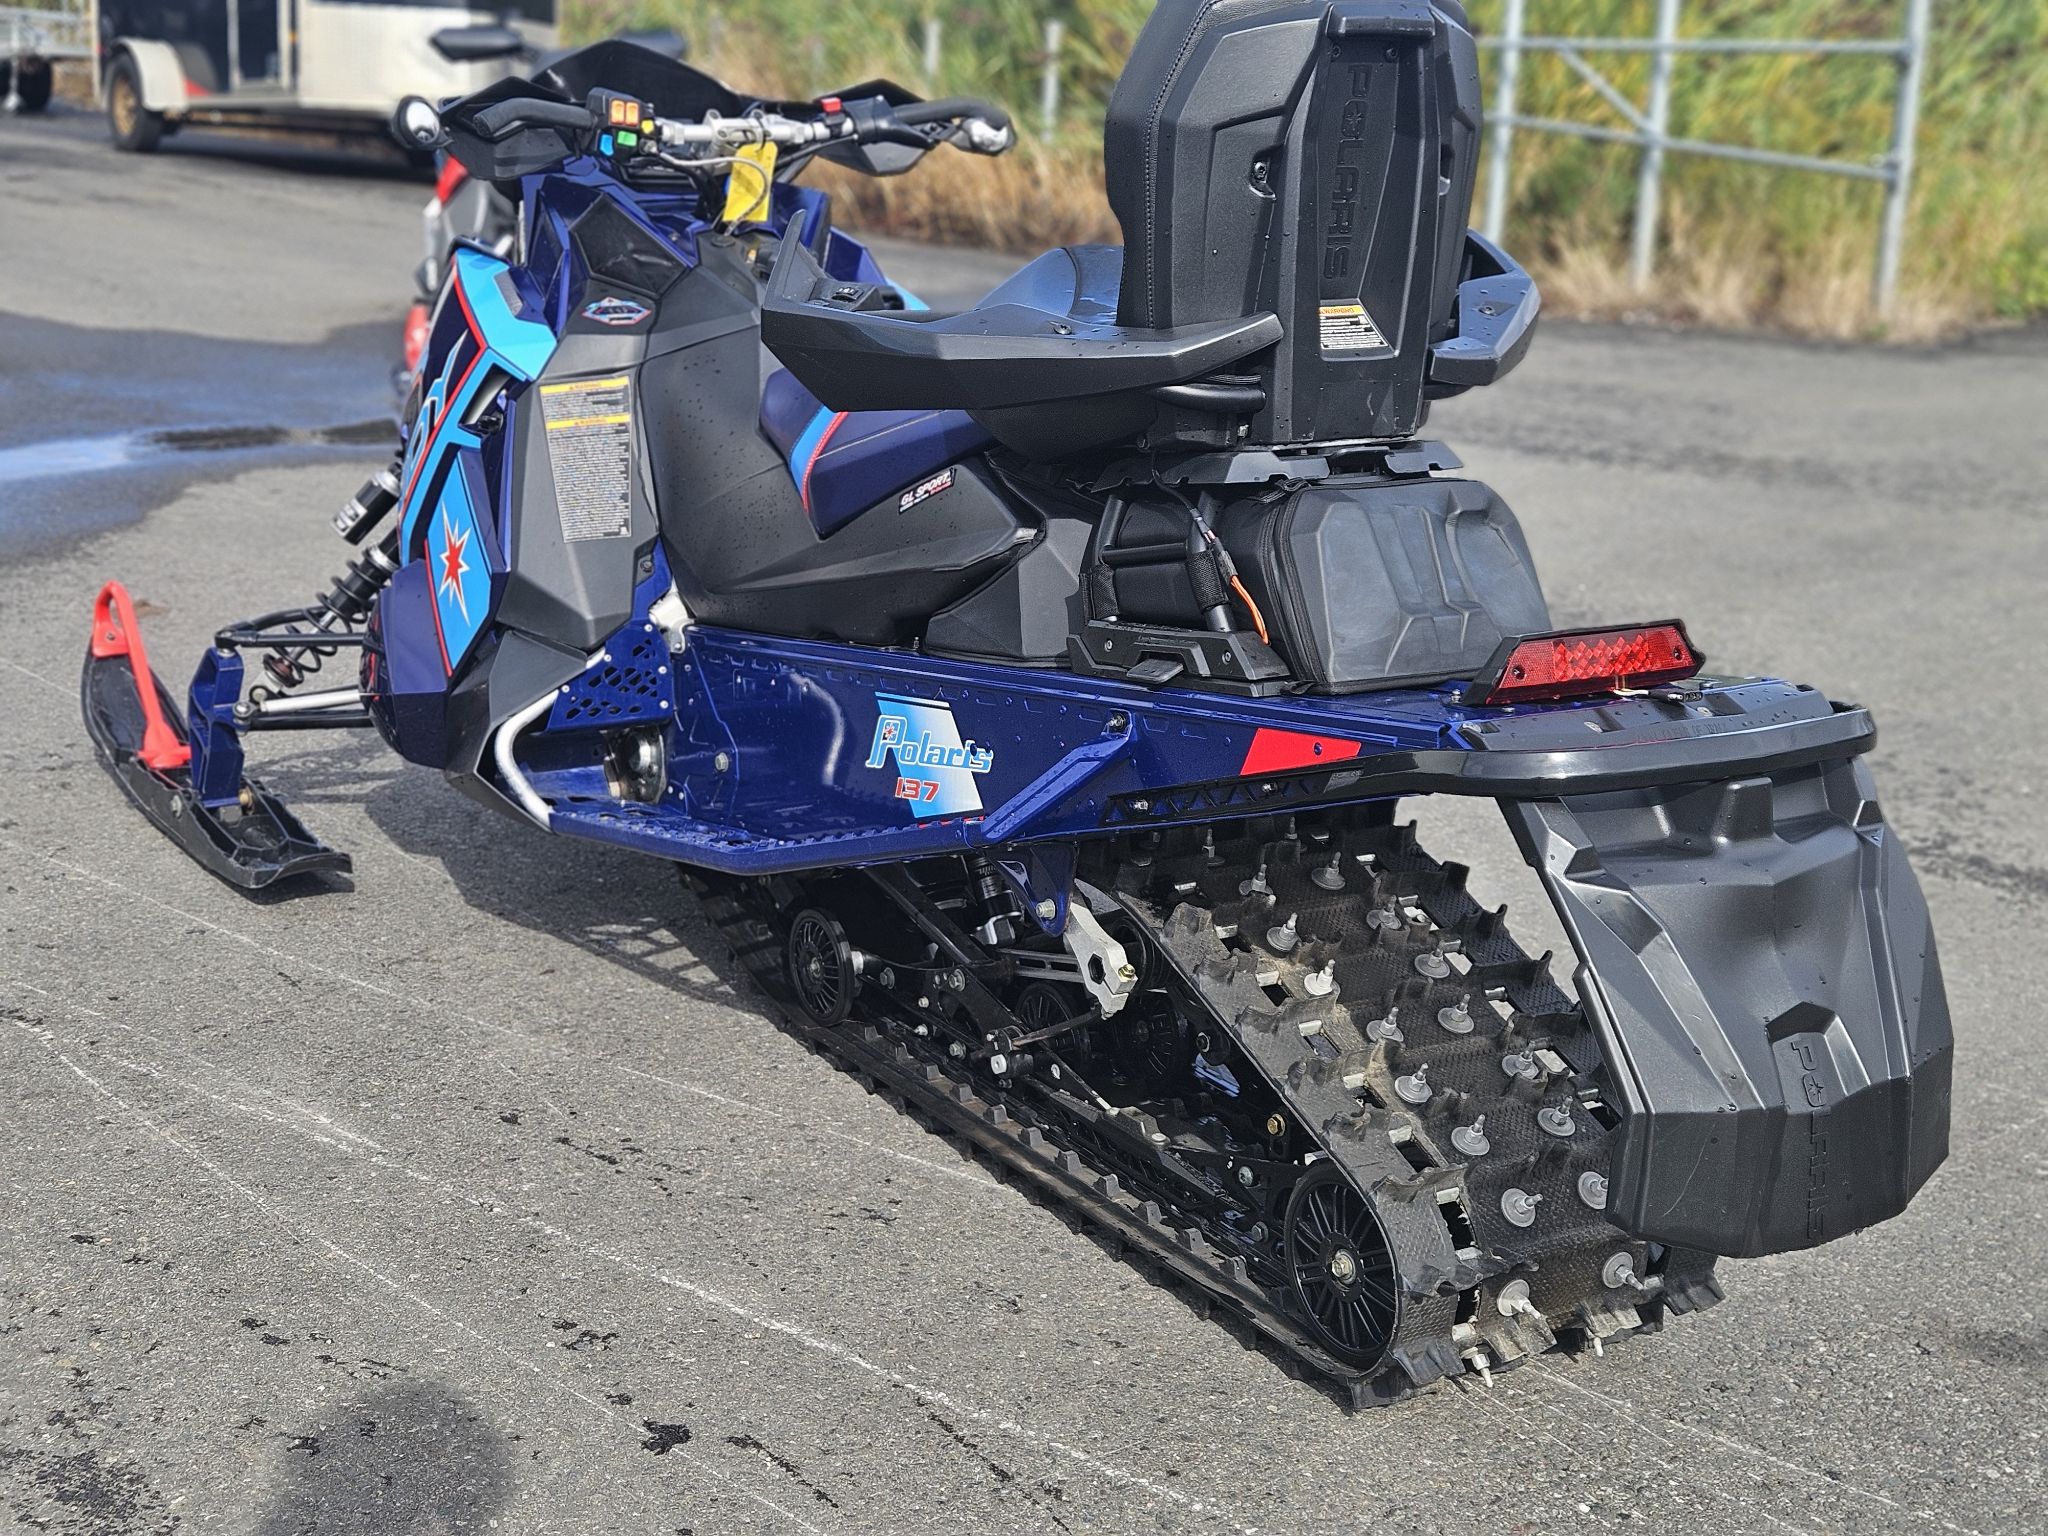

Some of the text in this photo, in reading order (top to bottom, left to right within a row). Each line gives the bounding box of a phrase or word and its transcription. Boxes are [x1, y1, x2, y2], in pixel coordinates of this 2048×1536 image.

[1323, 63, 1373, 280] POLARIS
[914, 470, 951, 498] SPORT
[865, 714, 994, 774] Polaris
[894, 776, 941, 802] 137
[1790, 1041, 1832, 1240] POLARIS
